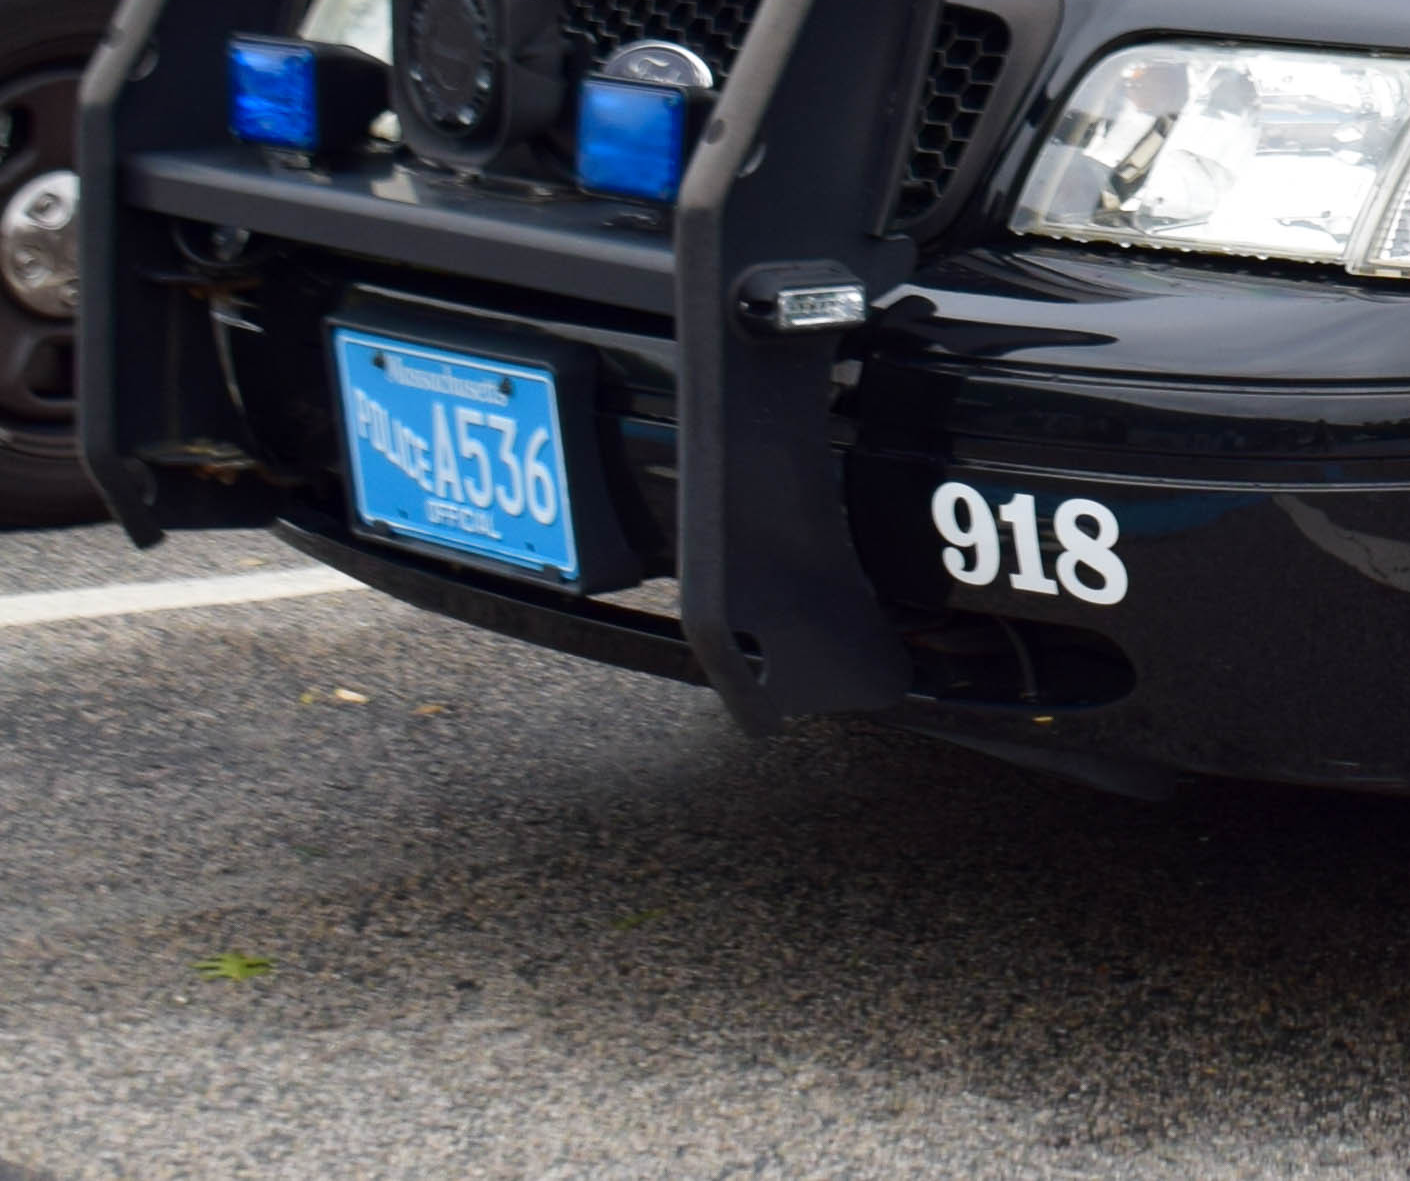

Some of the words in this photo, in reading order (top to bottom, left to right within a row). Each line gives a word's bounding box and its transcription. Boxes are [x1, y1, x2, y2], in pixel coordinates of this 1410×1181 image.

[352, 387, 434, 493] POLICE
[431, 402, 558, 525] A536
[425, 497, 503, 540] OFFICIAL
[931, 481, 1129, 605] 918
